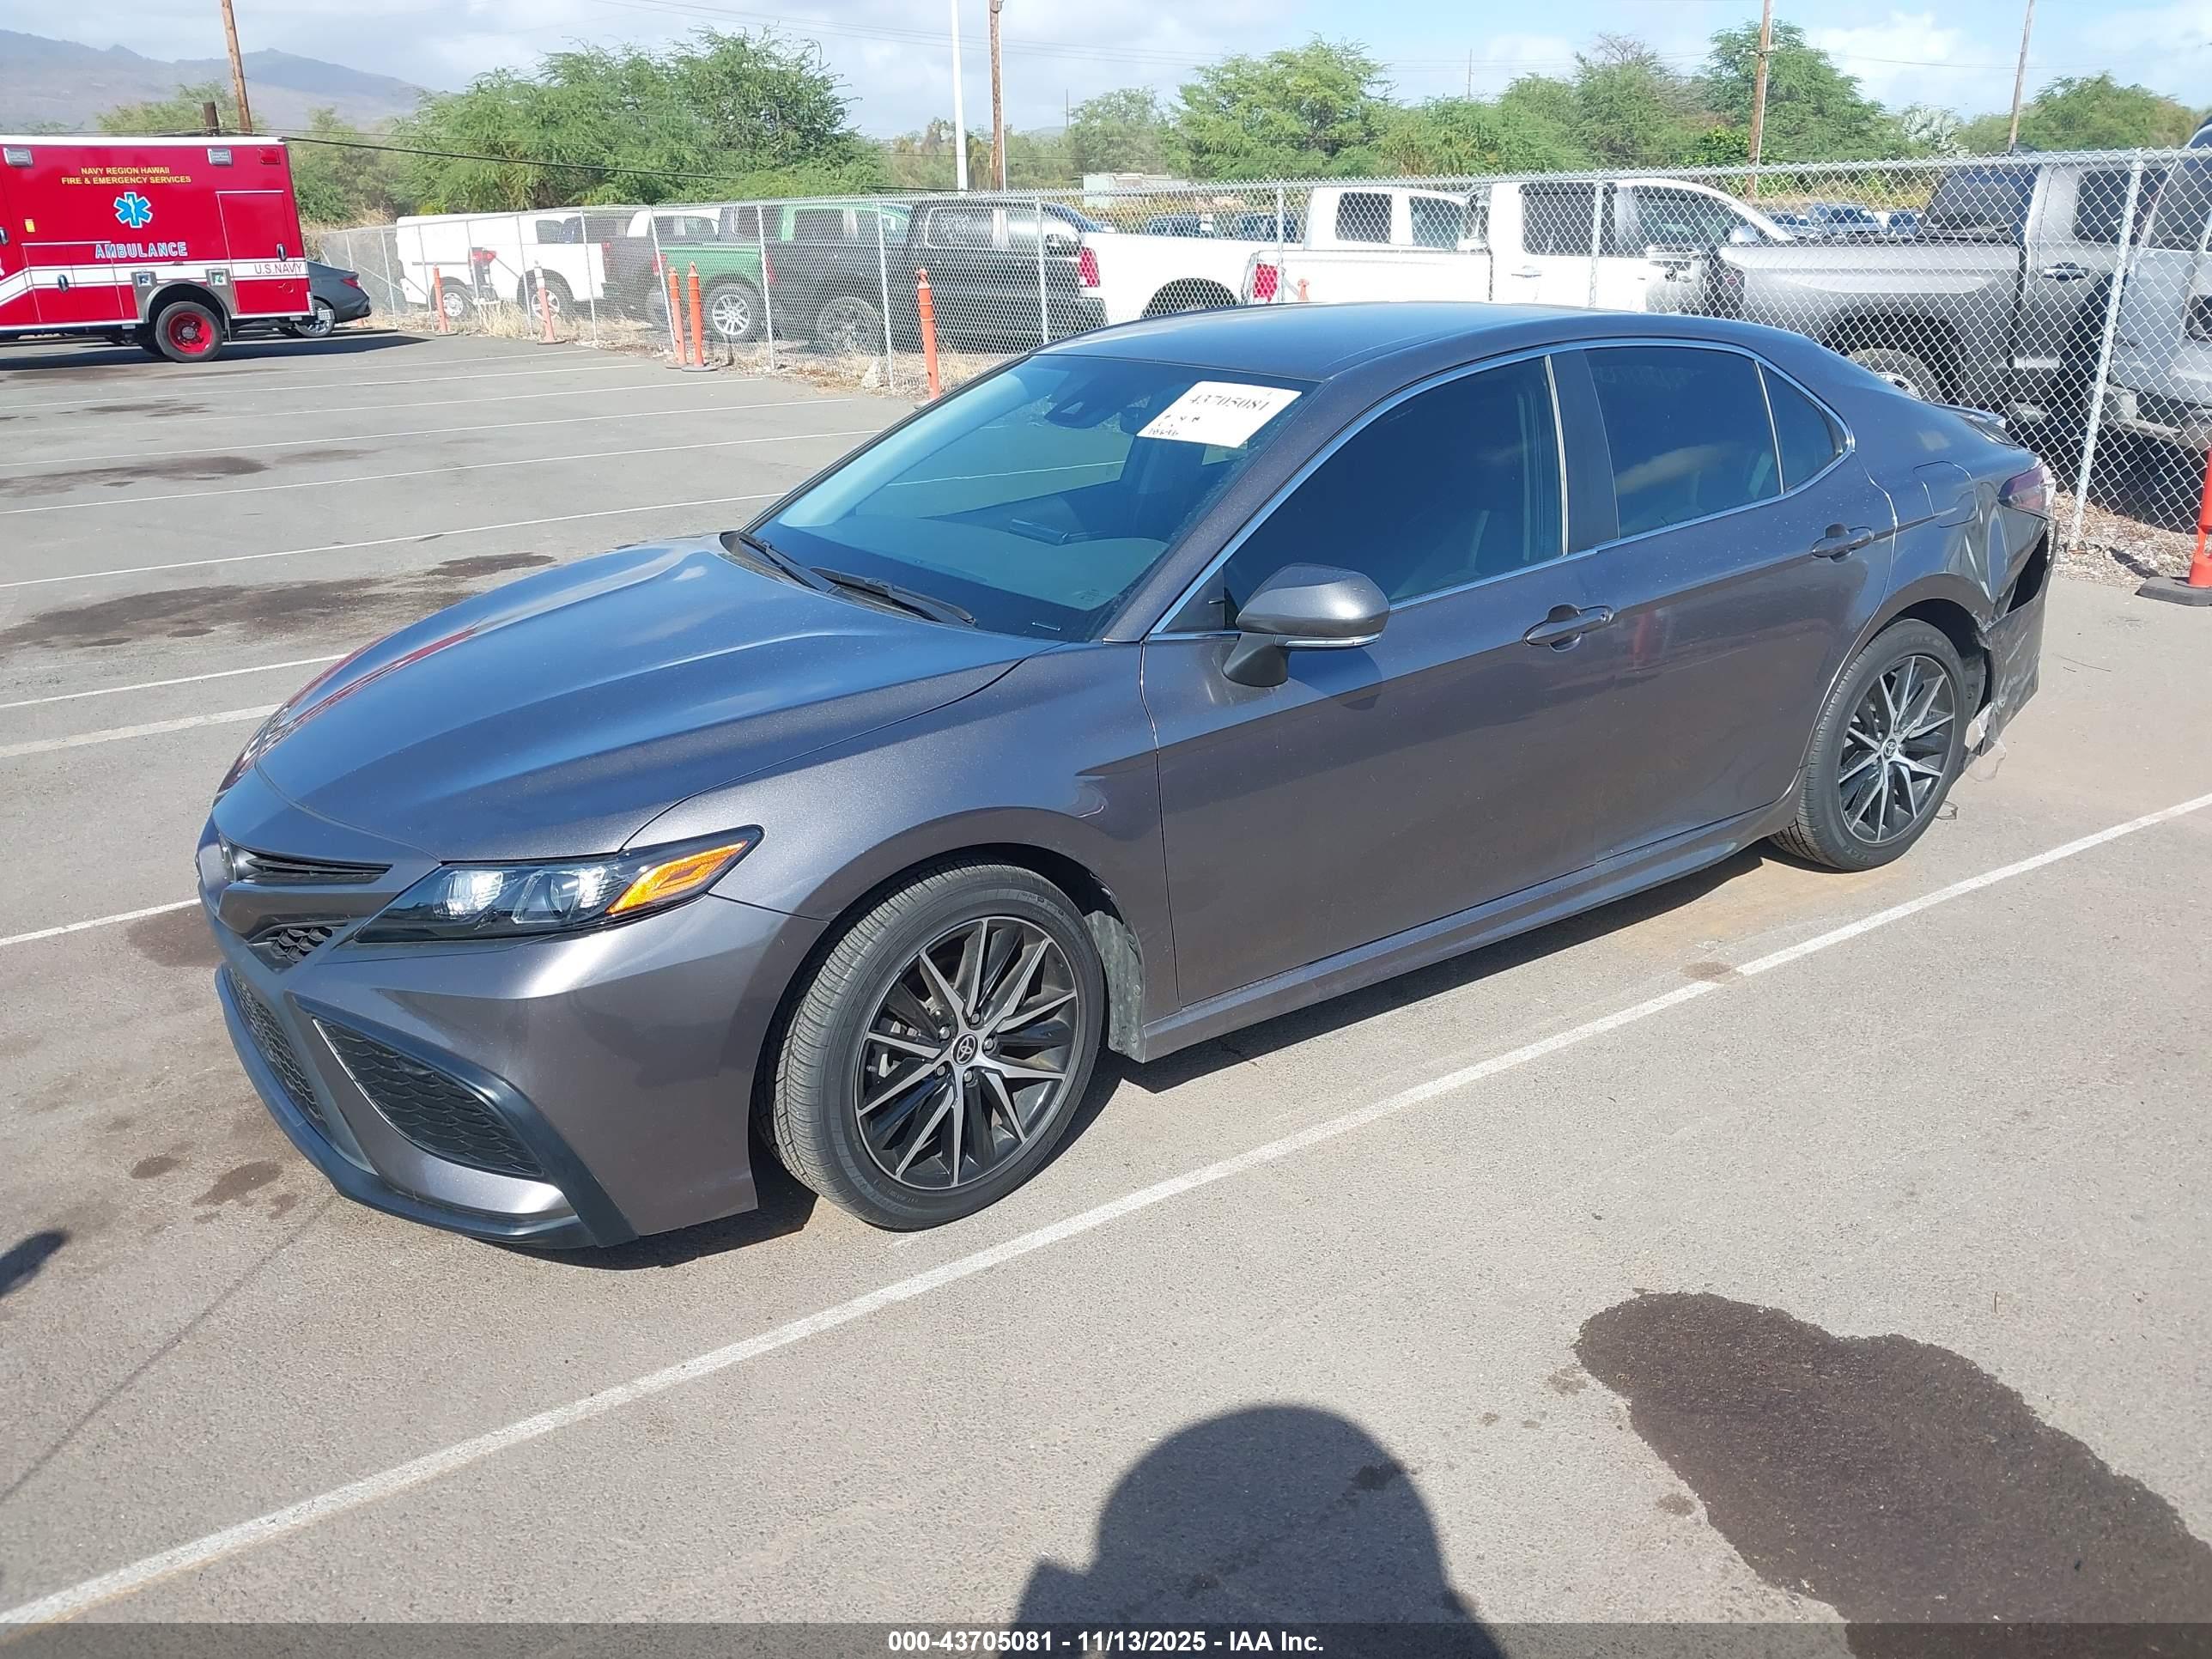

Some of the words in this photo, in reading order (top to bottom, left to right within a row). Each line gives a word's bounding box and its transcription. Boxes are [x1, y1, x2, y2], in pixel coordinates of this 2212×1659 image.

[93, 176, 148, 185] EMERGENCY
[149, 175, 191, 184] SERVICES
[94, 242, 188, 259] AMBULANCE
